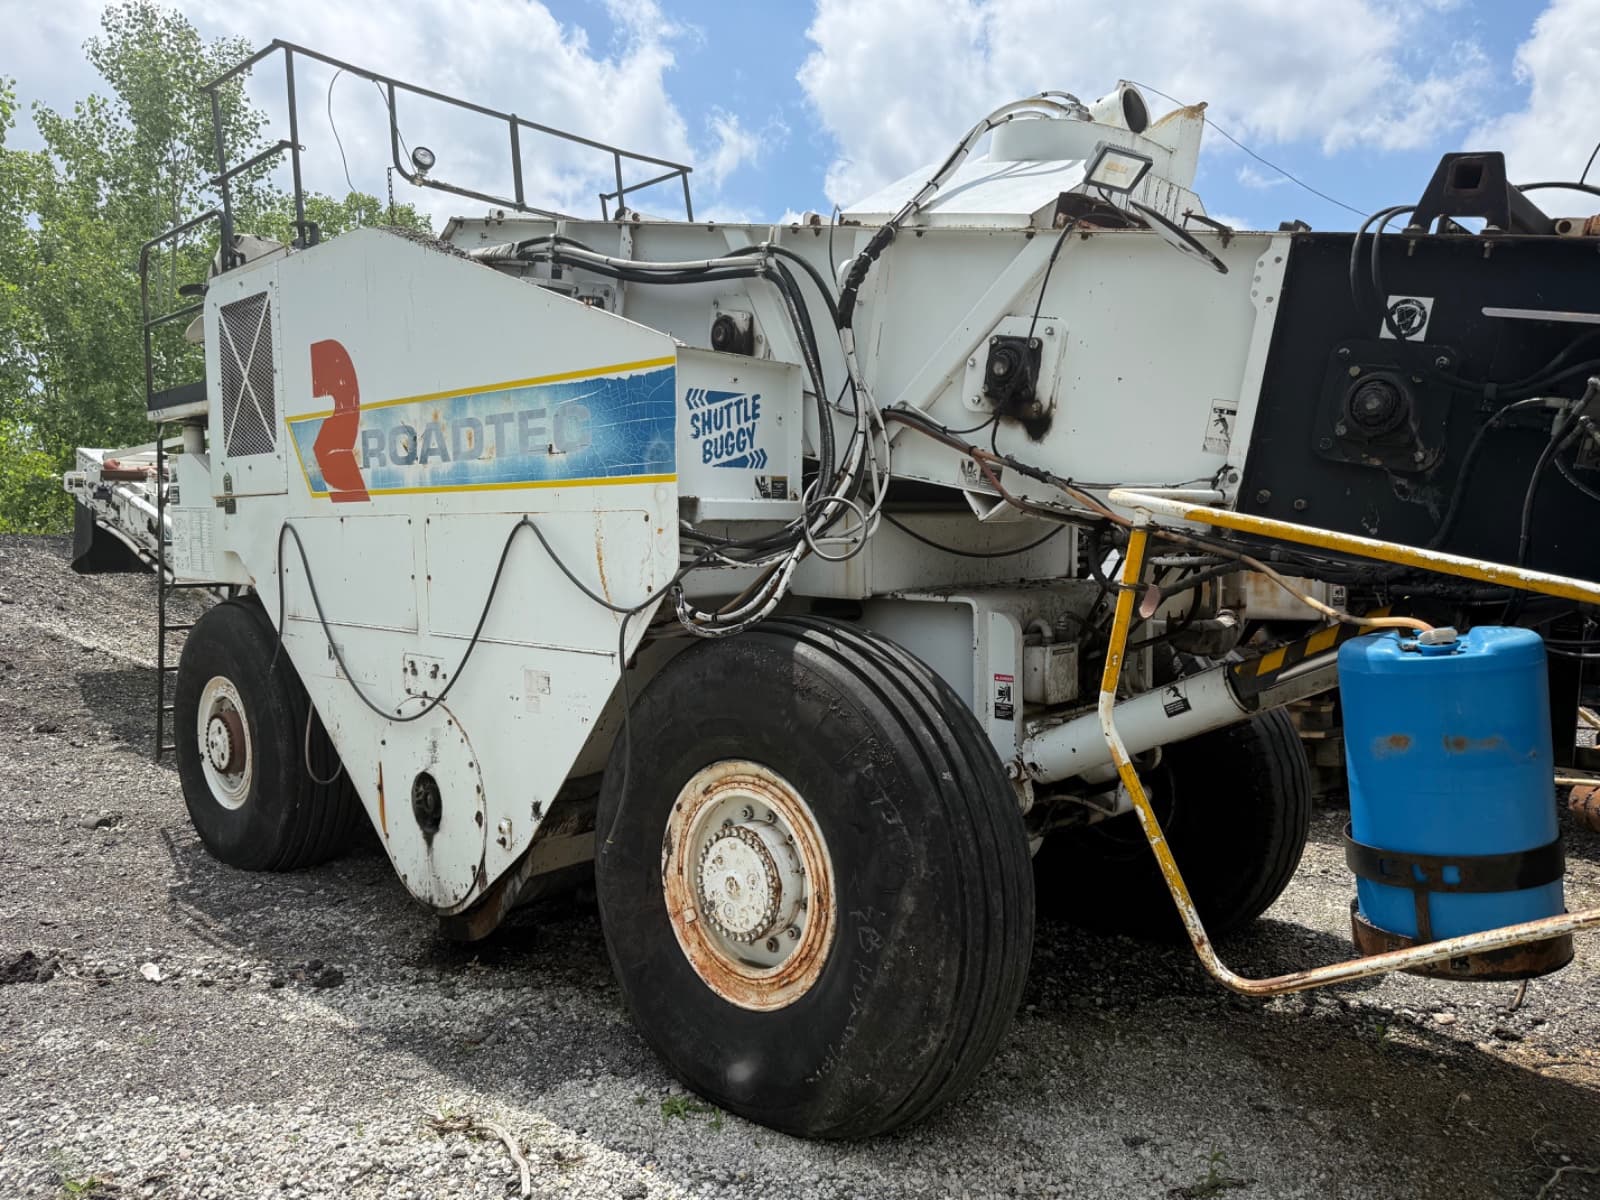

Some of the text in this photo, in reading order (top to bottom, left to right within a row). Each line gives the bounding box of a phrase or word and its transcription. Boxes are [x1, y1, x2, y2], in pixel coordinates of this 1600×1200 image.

[361, 402, 592, 469] ROADTEC
[690, 394, 760, 439] SHUTTLE
[702, 422, 756, 464] BUGGY
